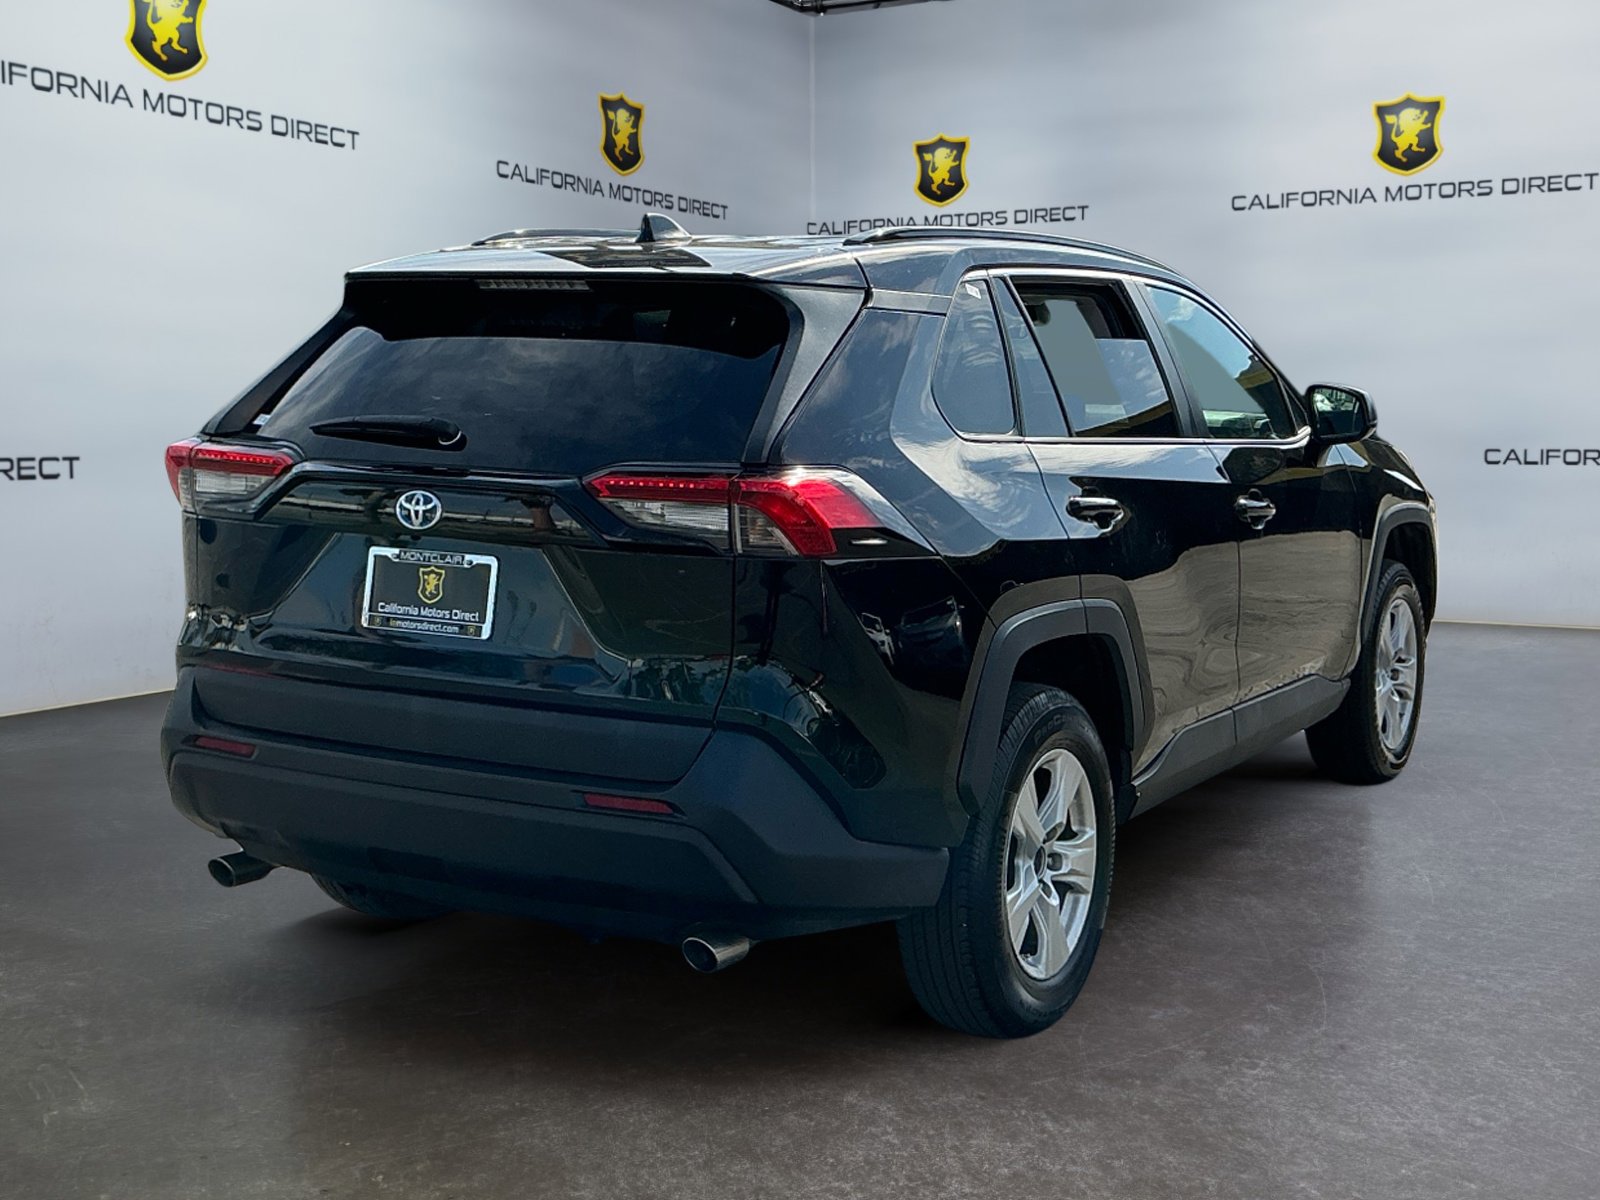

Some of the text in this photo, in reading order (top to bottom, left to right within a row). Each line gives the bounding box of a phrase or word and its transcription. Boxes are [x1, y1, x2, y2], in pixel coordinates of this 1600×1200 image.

[143, 89, 263, 132] MOTORS
[270, 115, 360, 150] DIRECT
[496, 160, 729, 220] CALIFORNIA MOTORS DIRECT
[1231, 172, 1600, 211] CALIFORNIA MOTORS DIRECT
[924, 210, 1008, 227] MOTORS
[1014, 205, 1089, 225] DIRECT
[400, 551, 463, 565] MONTCLAIR
[377, 602, 479, 622] California Motors Direct
